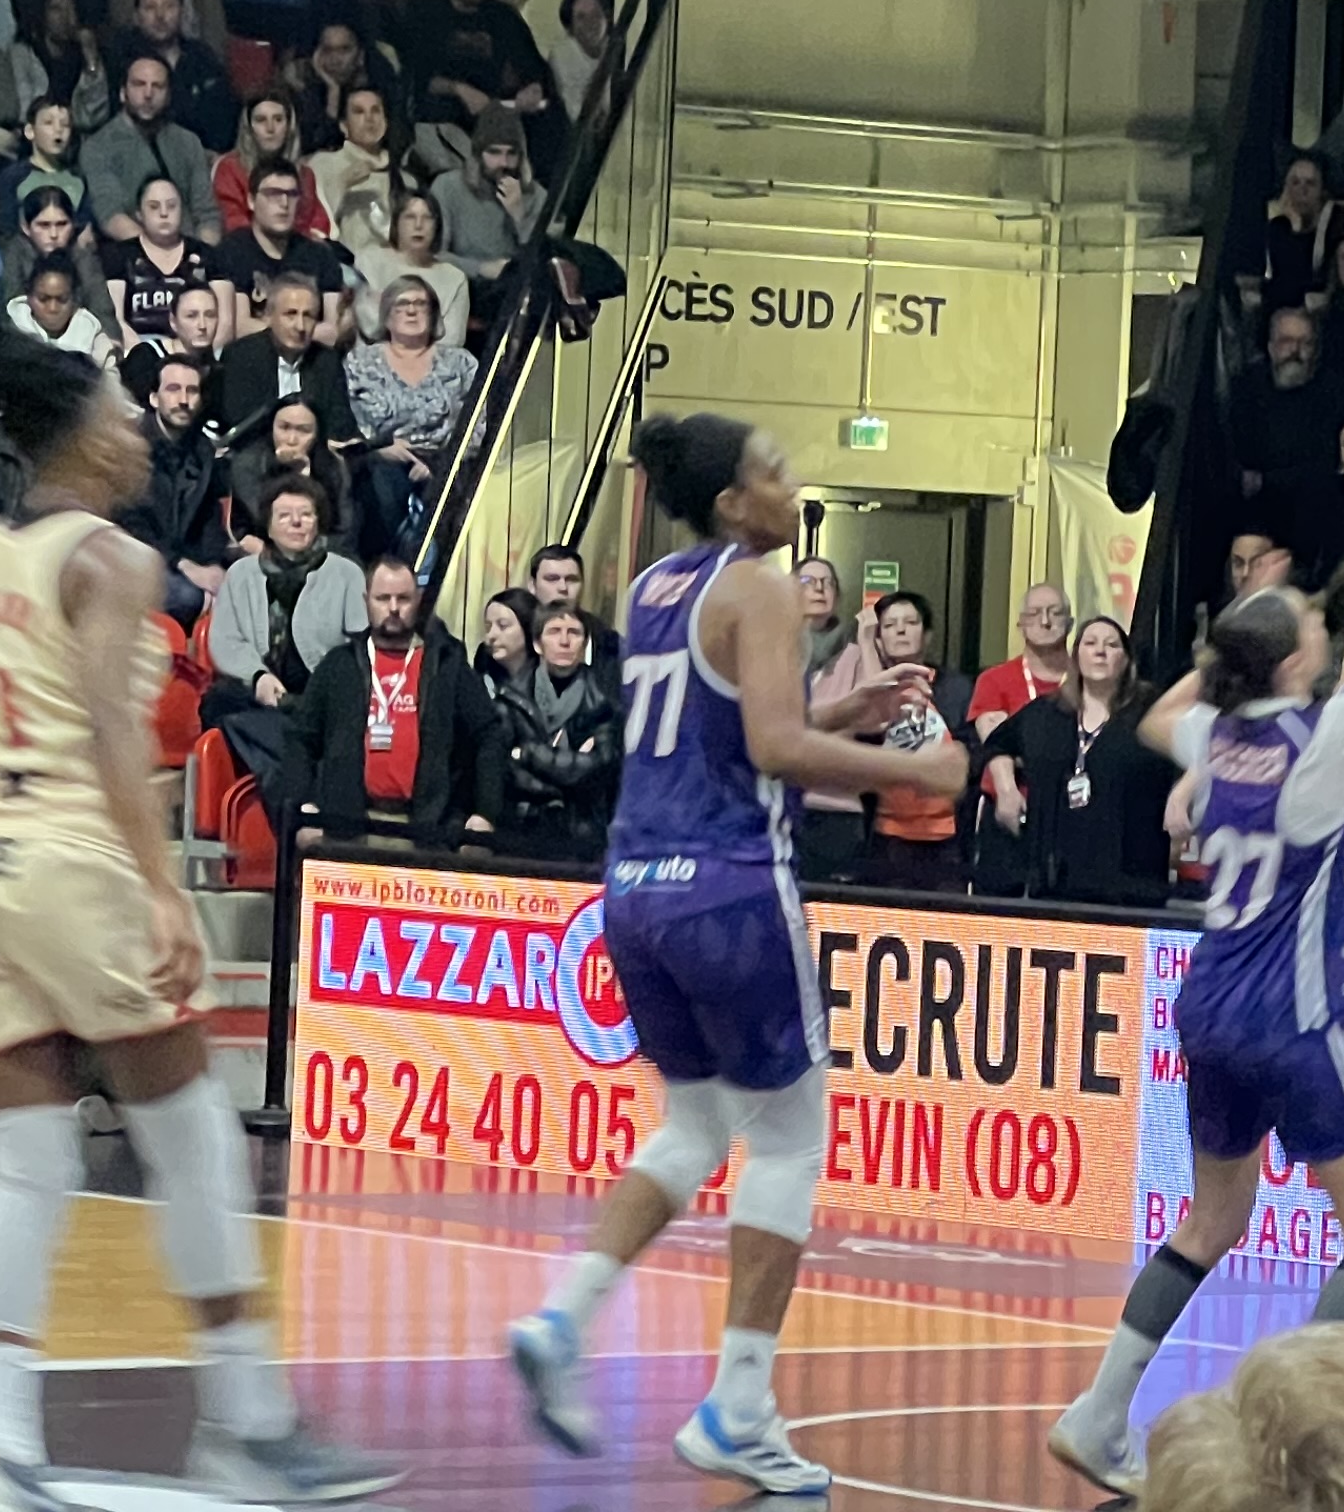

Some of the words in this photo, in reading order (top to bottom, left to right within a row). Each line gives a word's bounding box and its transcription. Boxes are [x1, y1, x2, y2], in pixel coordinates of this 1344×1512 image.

[659, 271, 736, 324] CÈS
[749, 287, 835, 331] SUD
[872, 292, 947, 337] EST
[818, 931, 1128, 1096] ECRUTE
[305, 1050, 369, 1145] 03
[389, 1060, 451, 1155] 24
[473, 1071, 542, 1166] 40
[567, 1080, 637, 1177] 05
[826, 1092, 944, 1193] EVIN
[965, 1107, 1082, 1207] (08)
